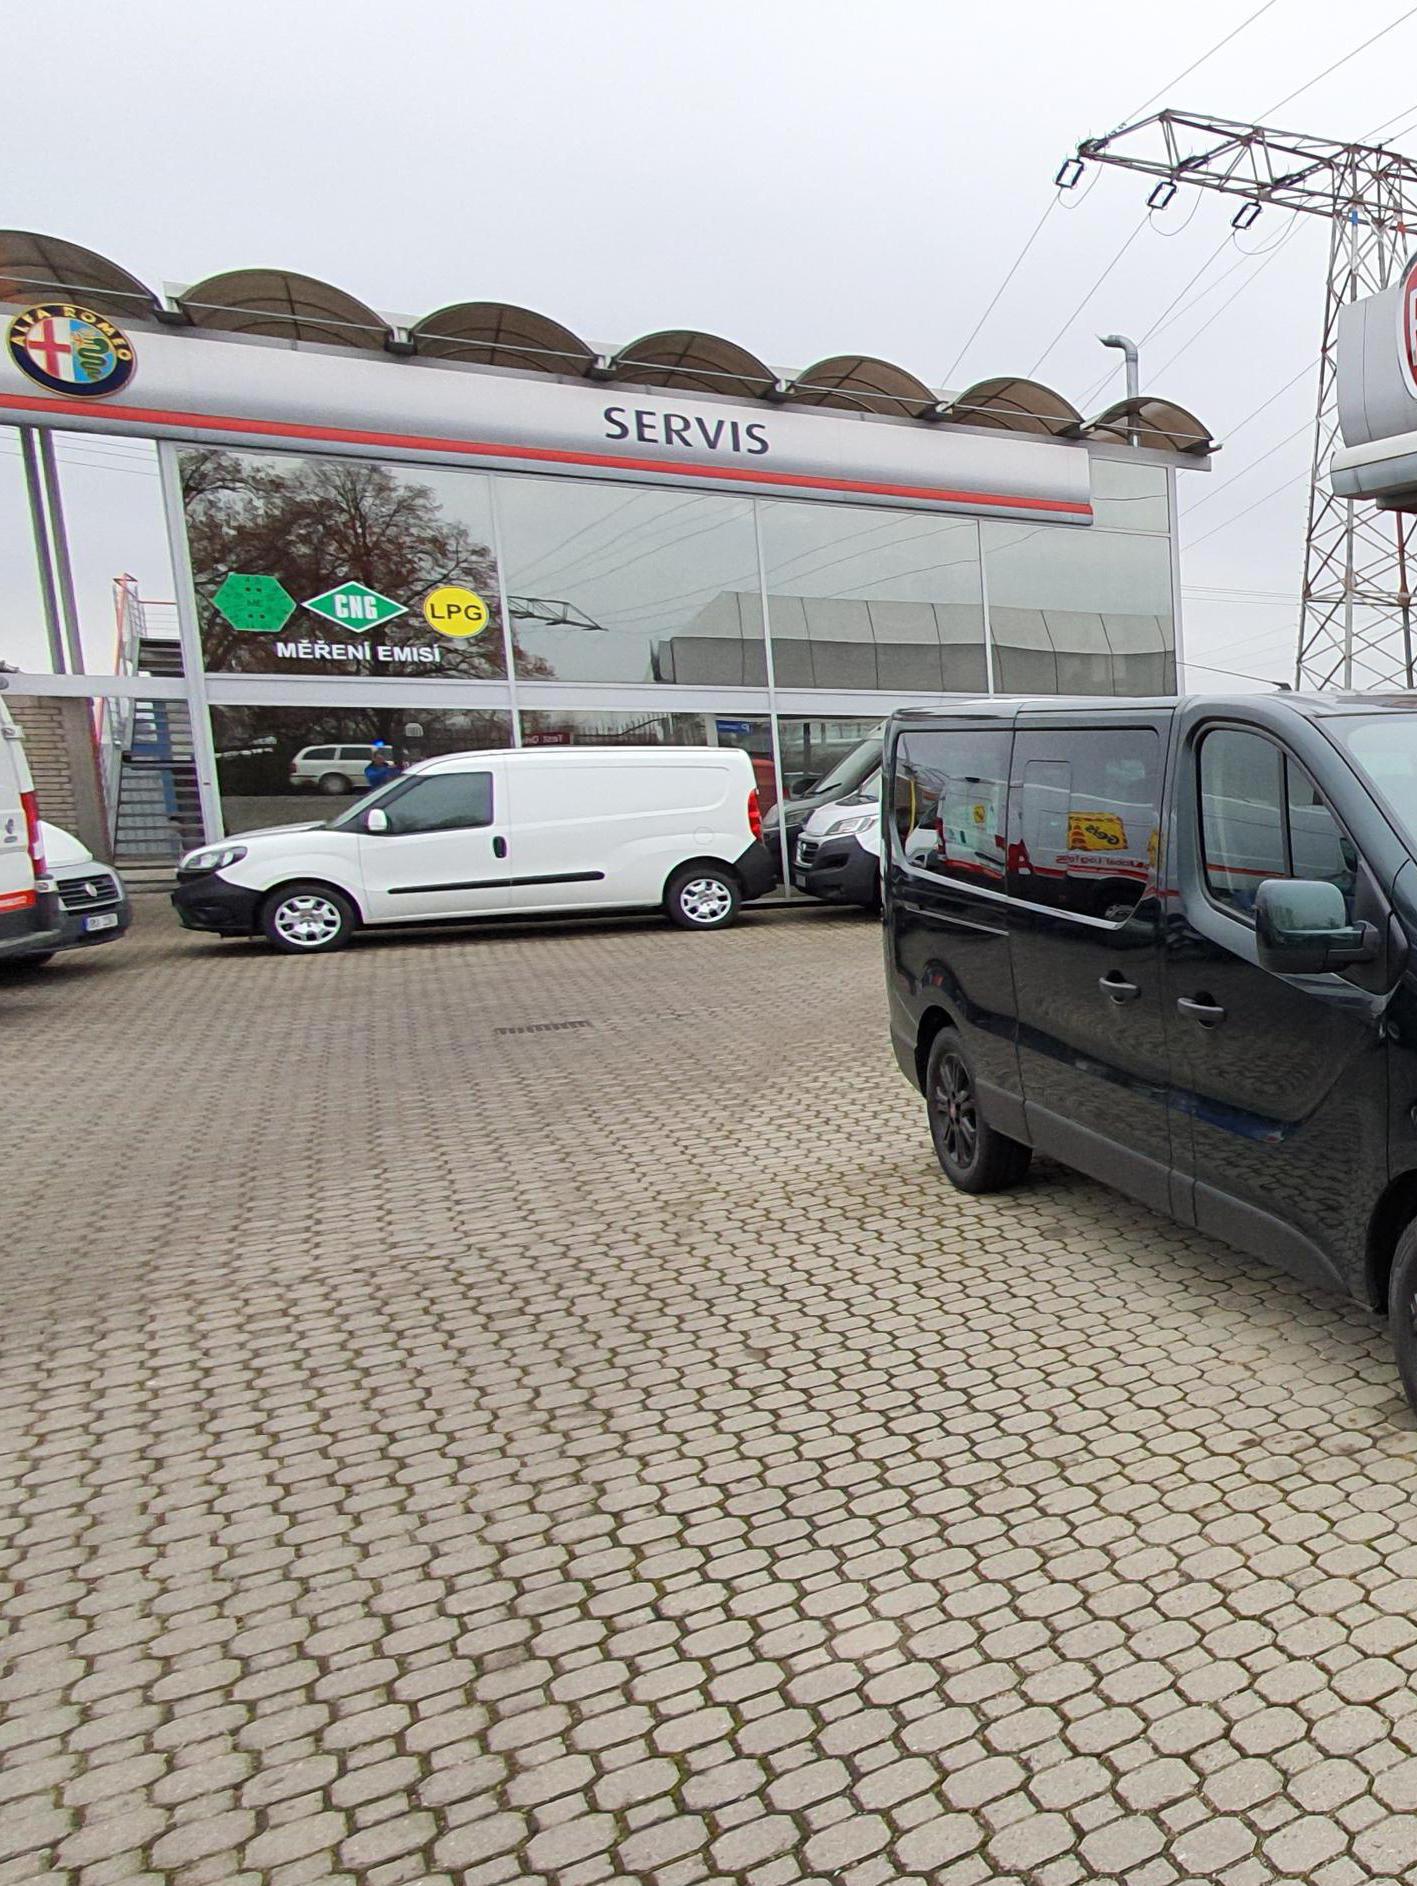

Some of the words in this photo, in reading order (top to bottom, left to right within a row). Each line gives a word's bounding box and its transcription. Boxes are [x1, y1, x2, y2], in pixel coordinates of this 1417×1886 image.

[10, 308, 52, 347] ALFA
[62, 306, 132, 361] ROMEO
[603, 406, 769, 455] SERVIS
[333, 594, 378, 619] CNG
[429, 603, 482, 621] LPG
[275, 640, 370, 661] MĚŘENÍ
[377, 643, 441, 663] EMISÍ
